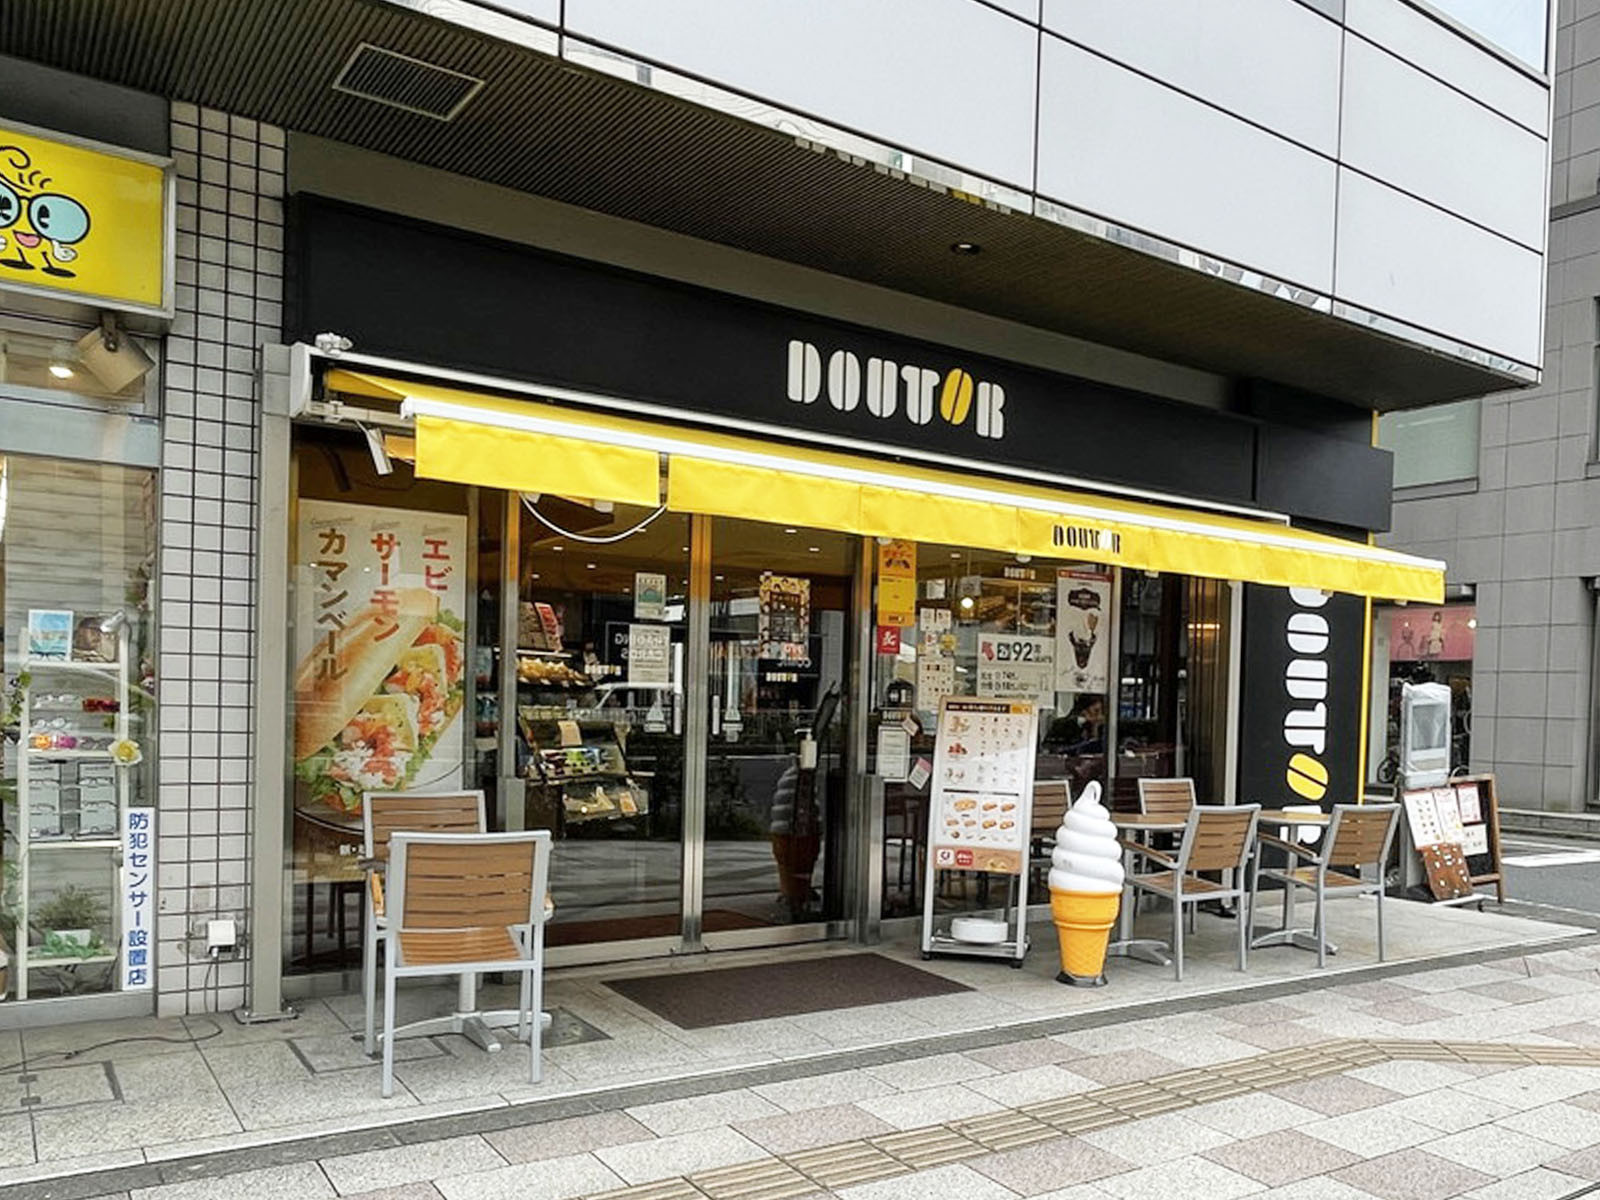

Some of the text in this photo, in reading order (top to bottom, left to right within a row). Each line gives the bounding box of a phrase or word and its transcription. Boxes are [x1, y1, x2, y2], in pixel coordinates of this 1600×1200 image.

[787, 340, 1006, 439] DOUTOR
[371, 533, 401, 642] サーモン
[422, 538, 453, 591] エビ
[1053, 525, 1121, 554] DOUTOR
[316, 527, 348, 681] カマンベール
[128, 812, 149, 986] 防犯センサー設置店
